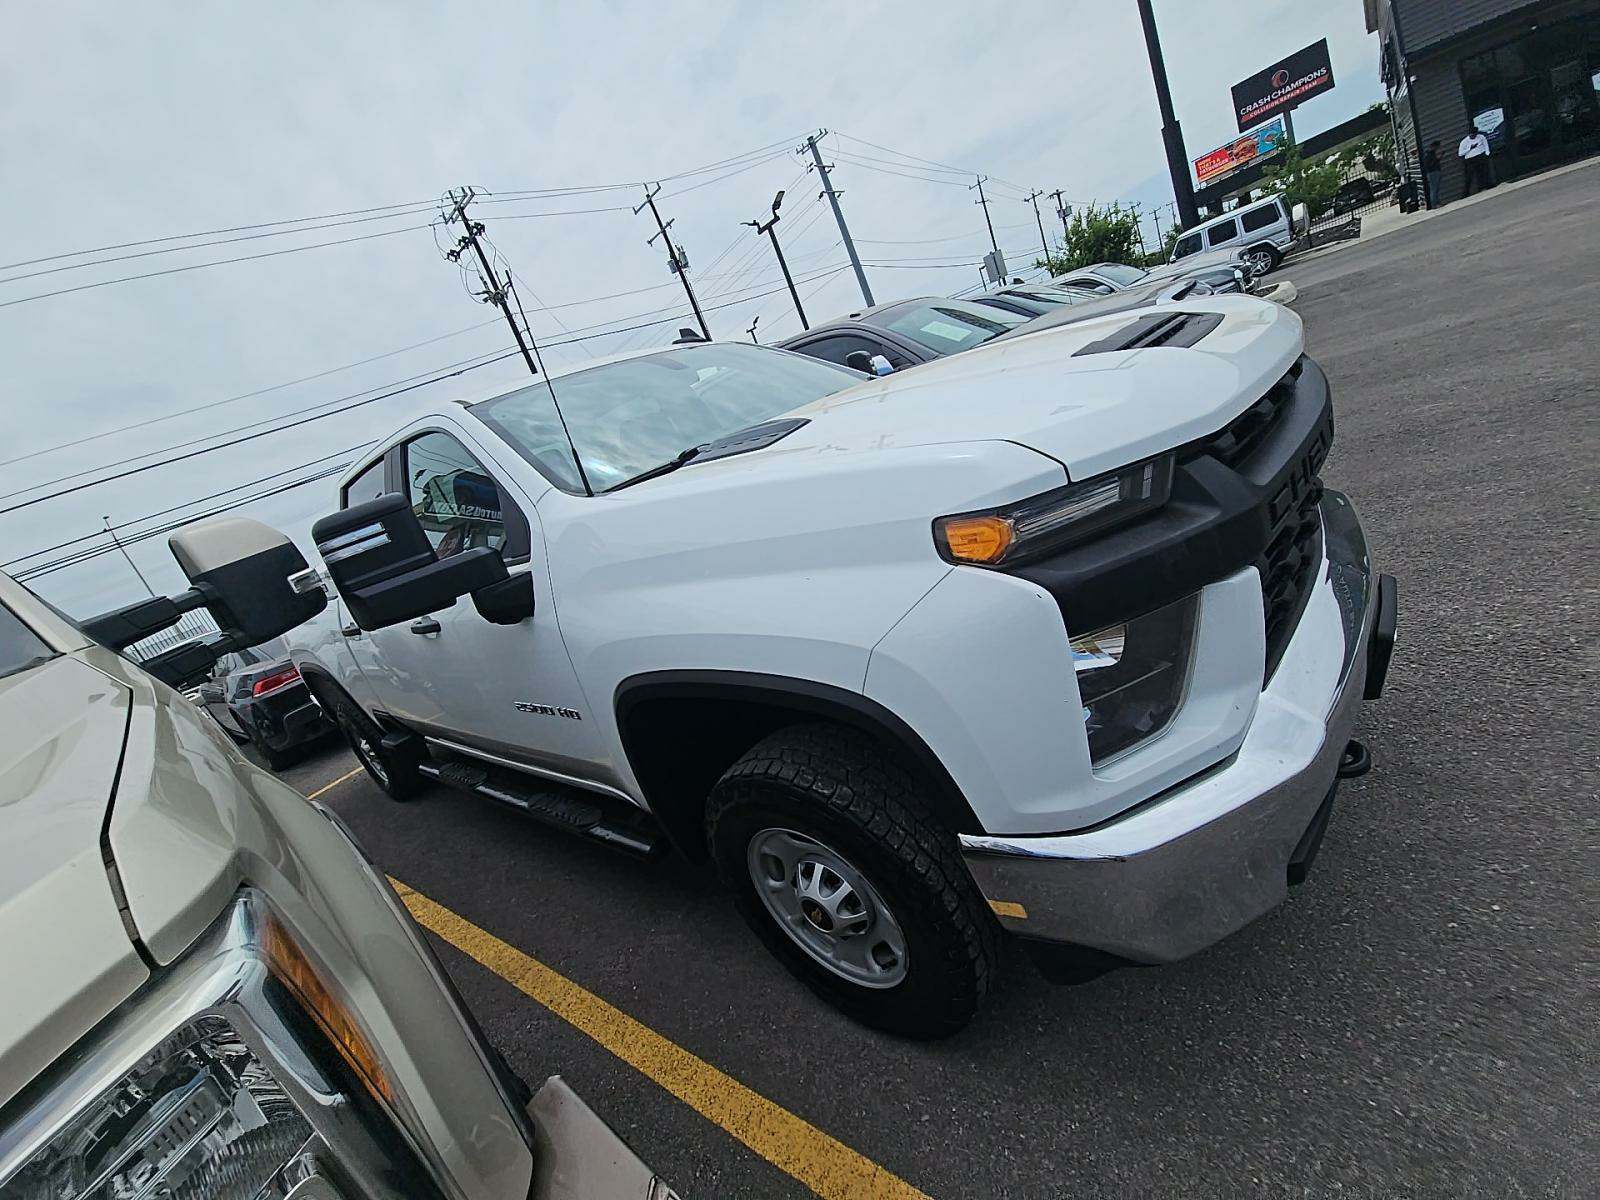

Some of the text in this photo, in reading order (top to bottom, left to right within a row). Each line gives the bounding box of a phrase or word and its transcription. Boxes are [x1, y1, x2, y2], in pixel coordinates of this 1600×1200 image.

[1240, 66, 1327, 116] CRASH CHAMPIONS
[513, 701, 582, 721] 2500 HD
